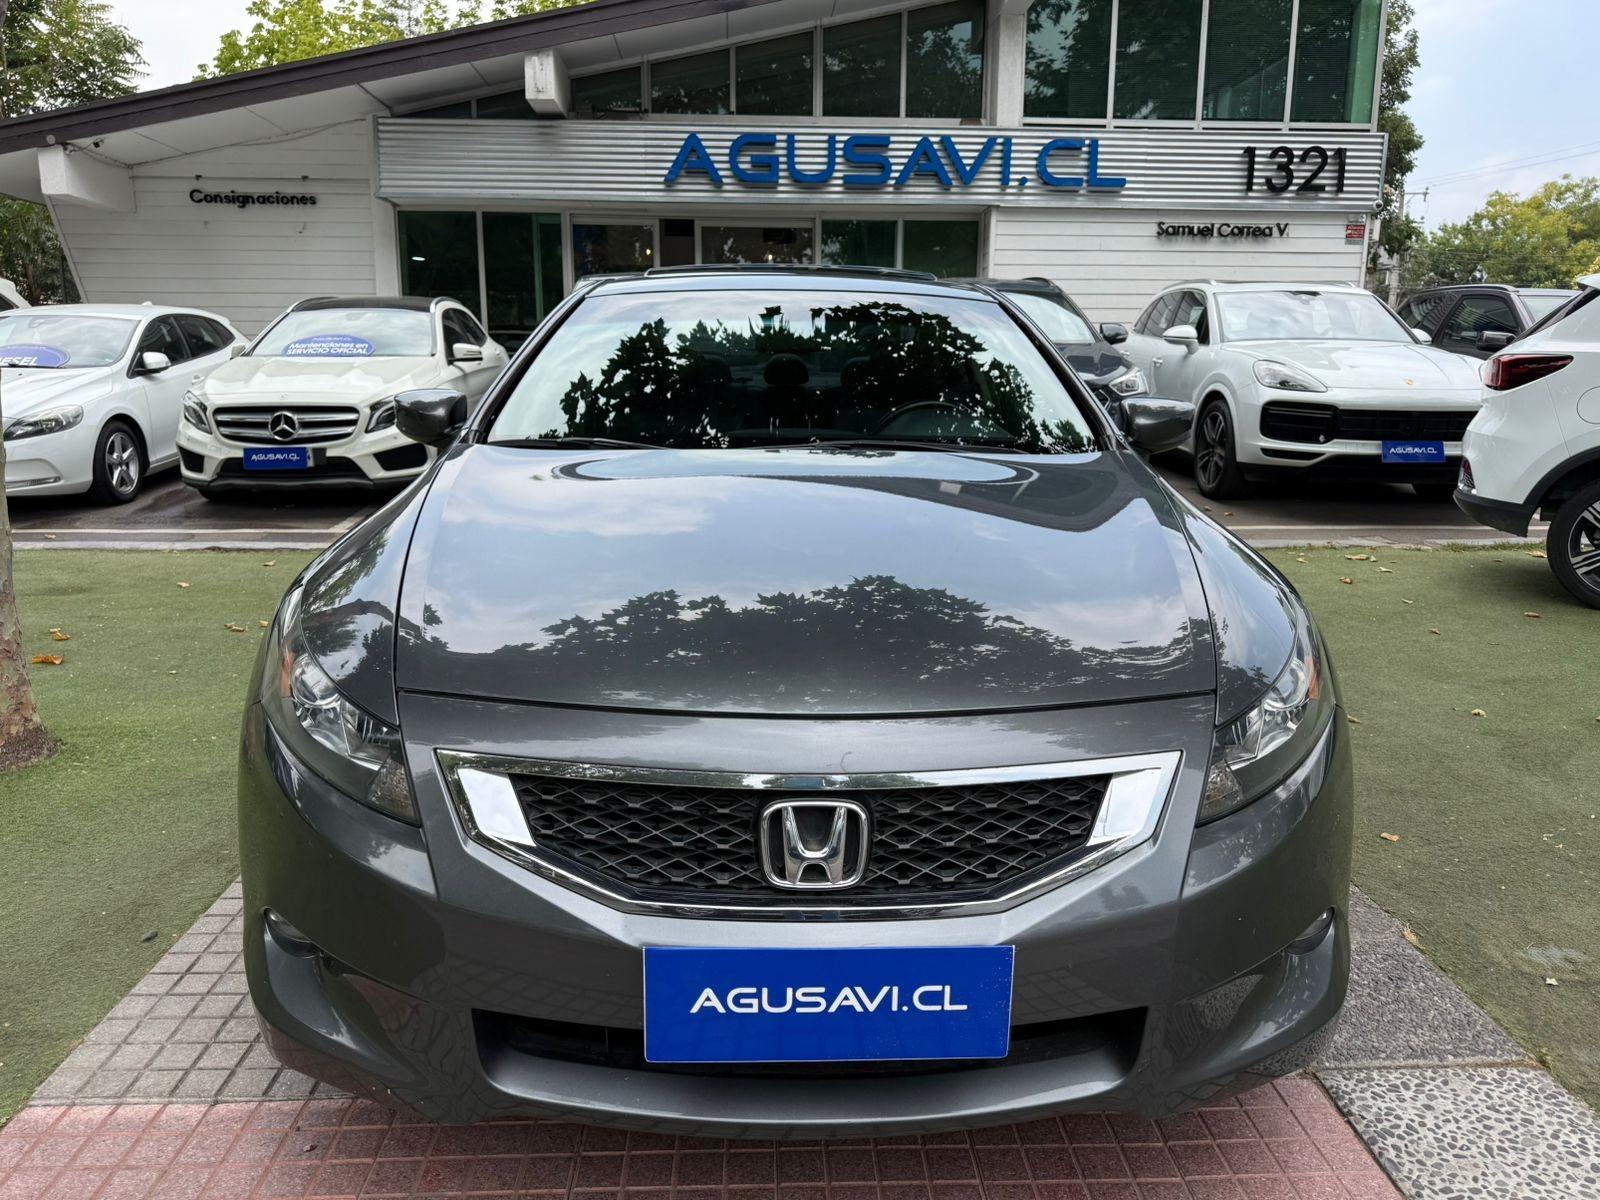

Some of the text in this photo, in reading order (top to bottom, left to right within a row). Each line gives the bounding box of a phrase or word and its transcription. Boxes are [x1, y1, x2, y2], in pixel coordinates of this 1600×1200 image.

[664, 132, 1127, 188] AGUSAVI.CL
[1242, 145, 1348, 194] 1321
[189, 188, 317, 209] Consignaciones
[1157, 221, 1215, 237] Samuel
[1218, 223, 1273, 237] Correa
[289, 341, 354, 349] Mantenciones
[250, 453, 300, 461] AGUSAVI.CL
[689, 985, 968, 1014] AGUSAVI.CL
